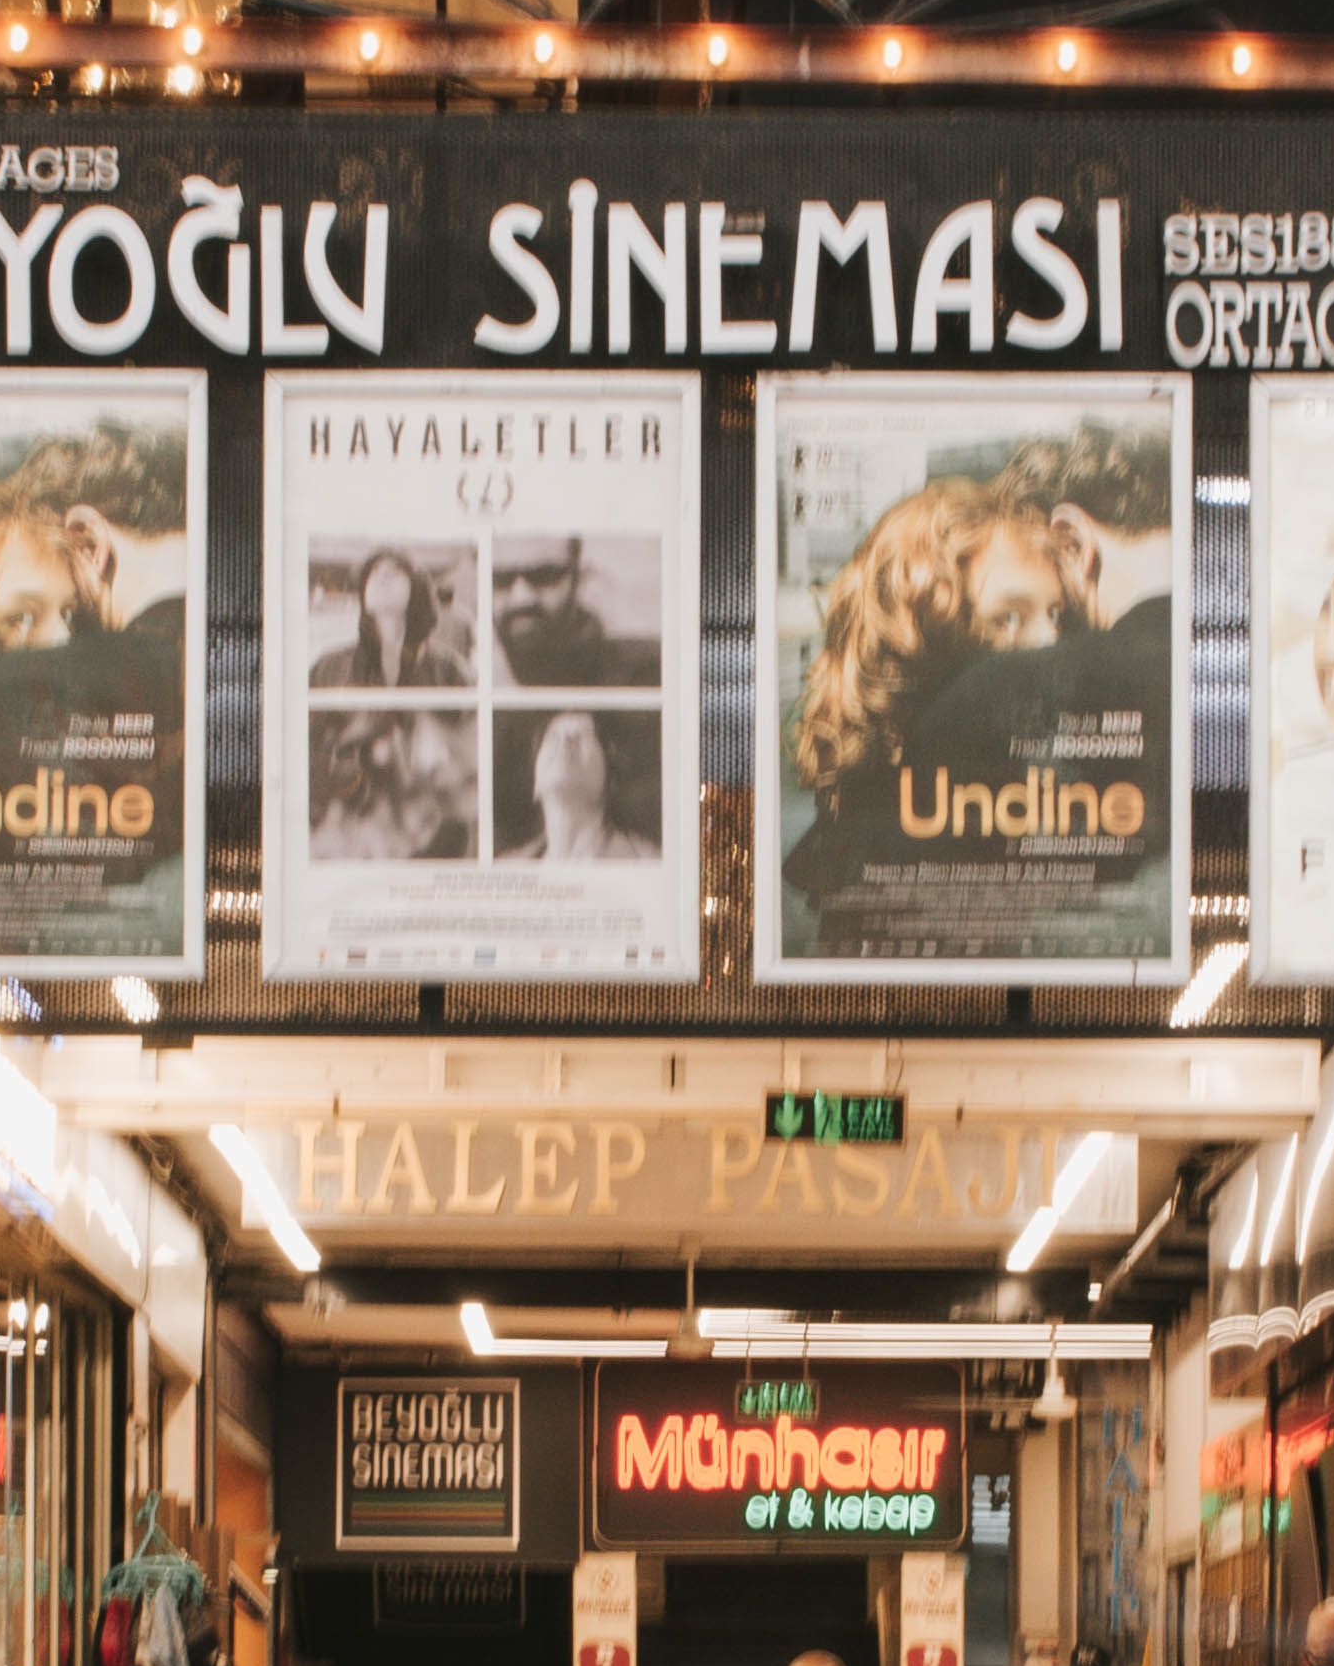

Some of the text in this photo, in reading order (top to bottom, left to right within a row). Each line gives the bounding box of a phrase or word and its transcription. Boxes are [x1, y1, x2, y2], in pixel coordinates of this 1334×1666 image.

[474, 177, 1122, 355] SİNEMASI
[309, 413, 664, 461] HAYALETLER
[899, 764, 1145, 839] Undine
[294, 1119, 647, 1218] HALEP
[352, 1387, 505, 1443] BEYOĞLU
[618, 1414, 947, 1491] Münhasır
[824, 1490, 936, 1536] kebap
